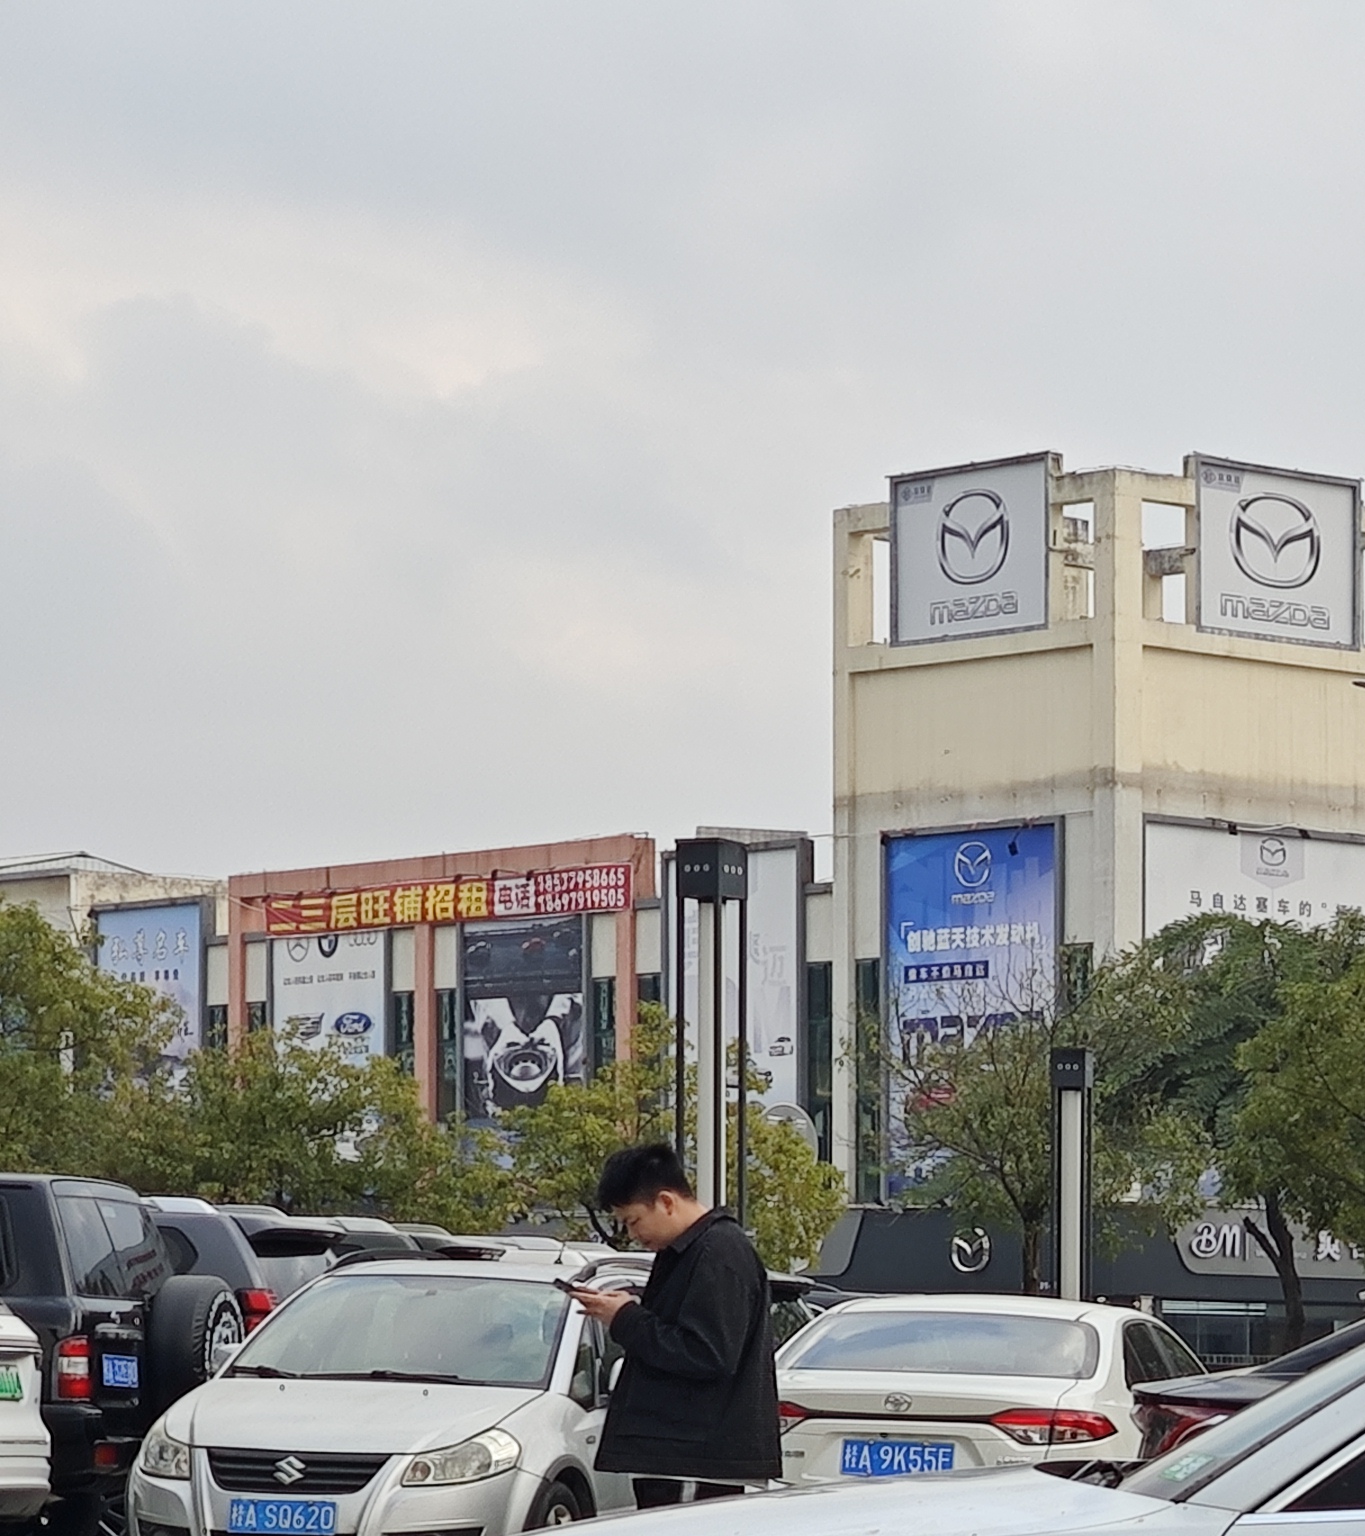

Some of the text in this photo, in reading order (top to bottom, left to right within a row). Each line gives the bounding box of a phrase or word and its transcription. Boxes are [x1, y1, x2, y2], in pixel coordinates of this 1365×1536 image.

[269, 880, 489, 932] 二三层旺铺招租
[499, 883, 531, 911] 电话
[264, 1504, 335, 1530] SQ620
